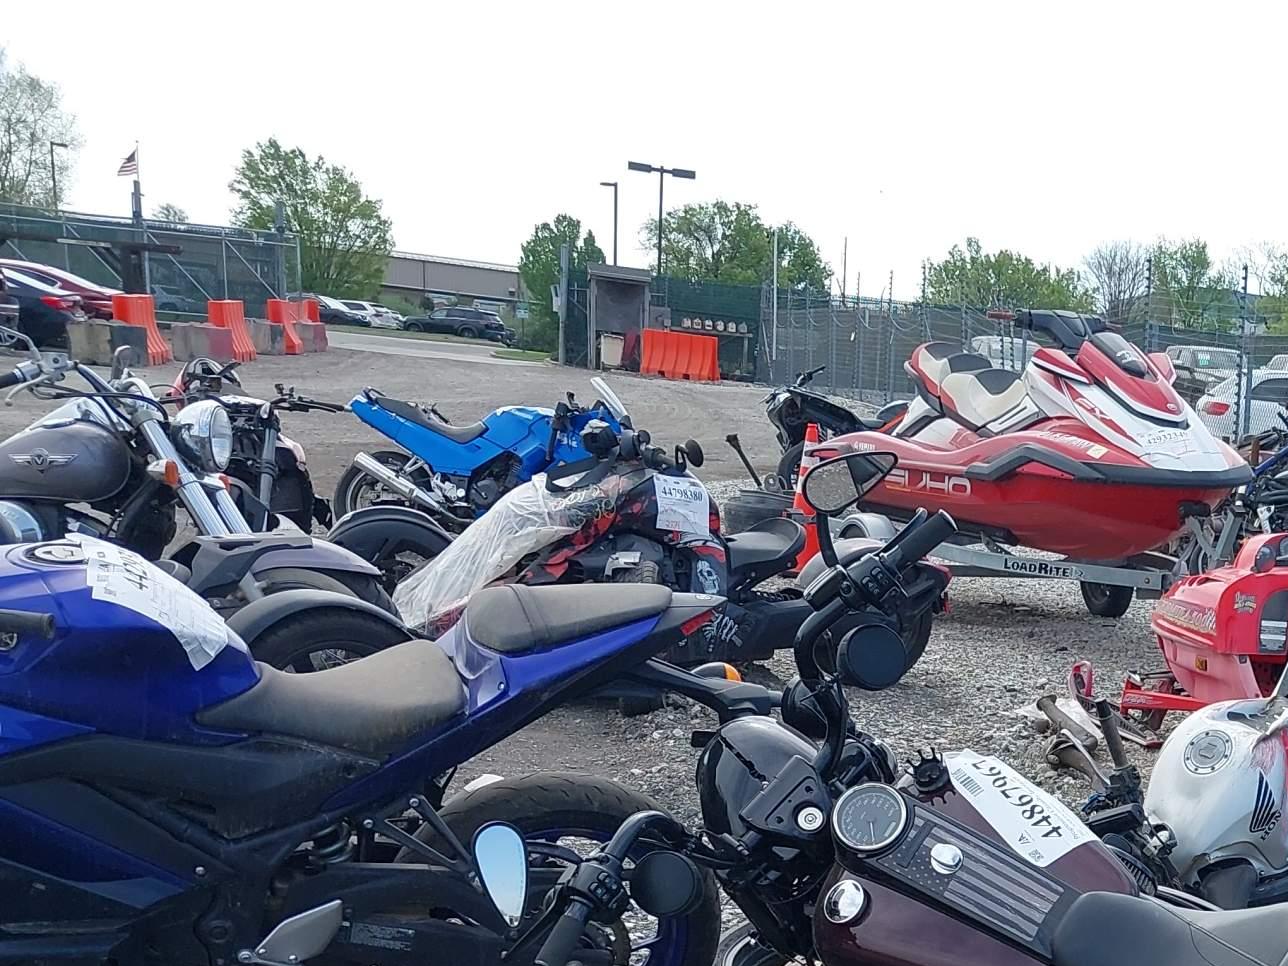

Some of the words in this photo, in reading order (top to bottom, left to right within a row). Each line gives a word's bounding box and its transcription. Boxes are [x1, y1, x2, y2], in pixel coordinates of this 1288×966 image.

[661, 485, 703, 502] 44798380
[971, 759, 1063, 838] 44867967
[1260, 809, 1283, 841] HON
